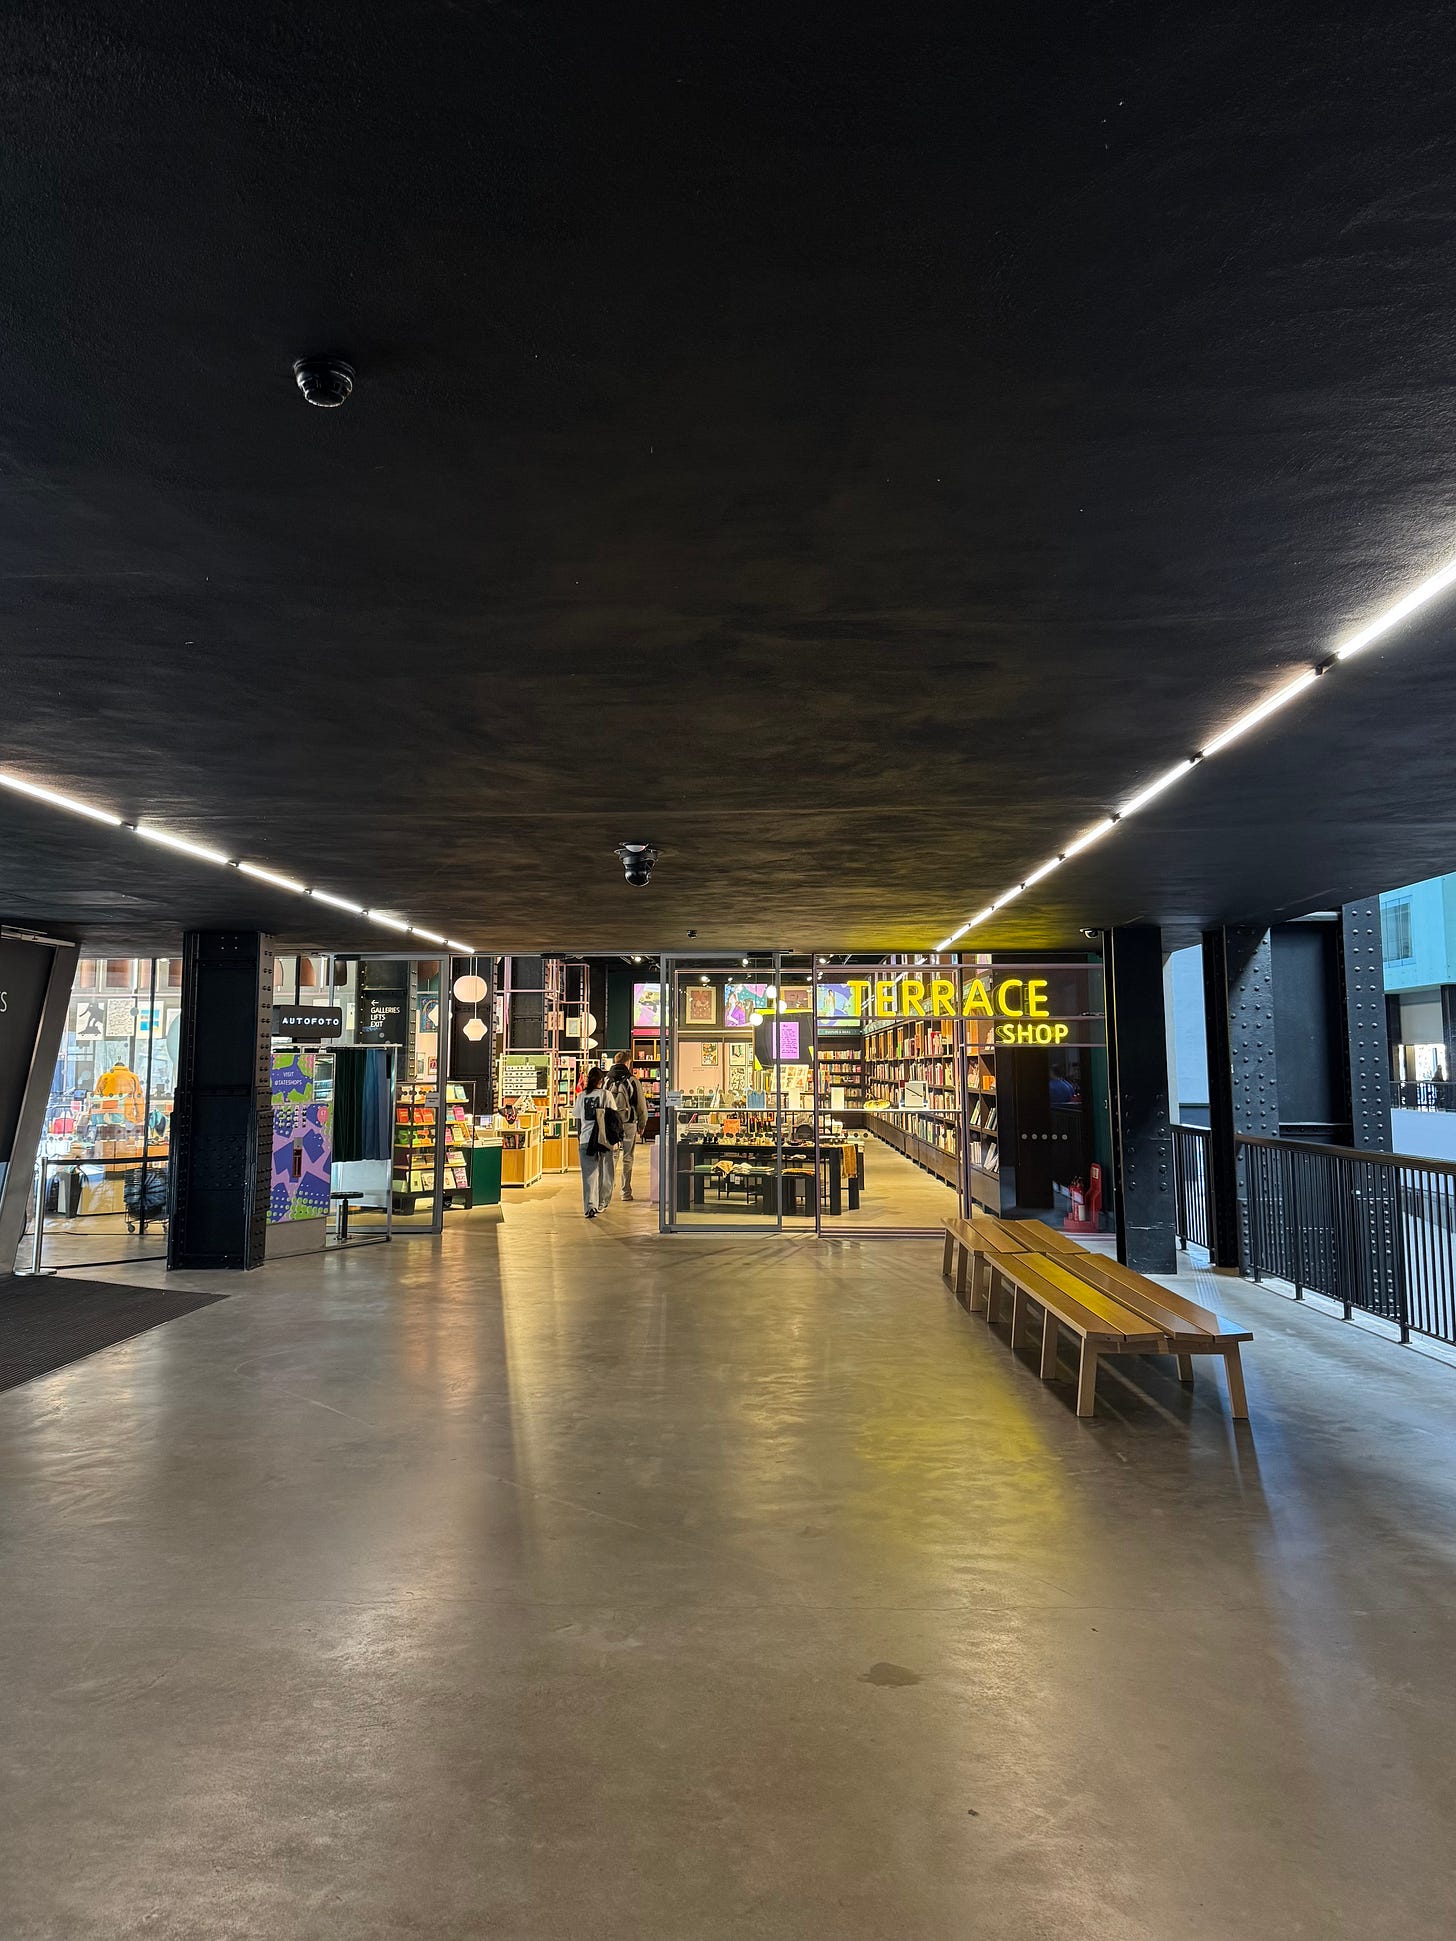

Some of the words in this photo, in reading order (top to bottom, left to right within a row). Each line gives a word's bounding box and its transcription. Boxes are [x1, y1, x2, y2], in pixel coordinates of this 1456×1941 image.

[847, 979, 1049, 1017] TERRACE
[282, 1017, 340, 1026] AUTOFOTO
[1003, 1023, 1068, 1044] SHOP
